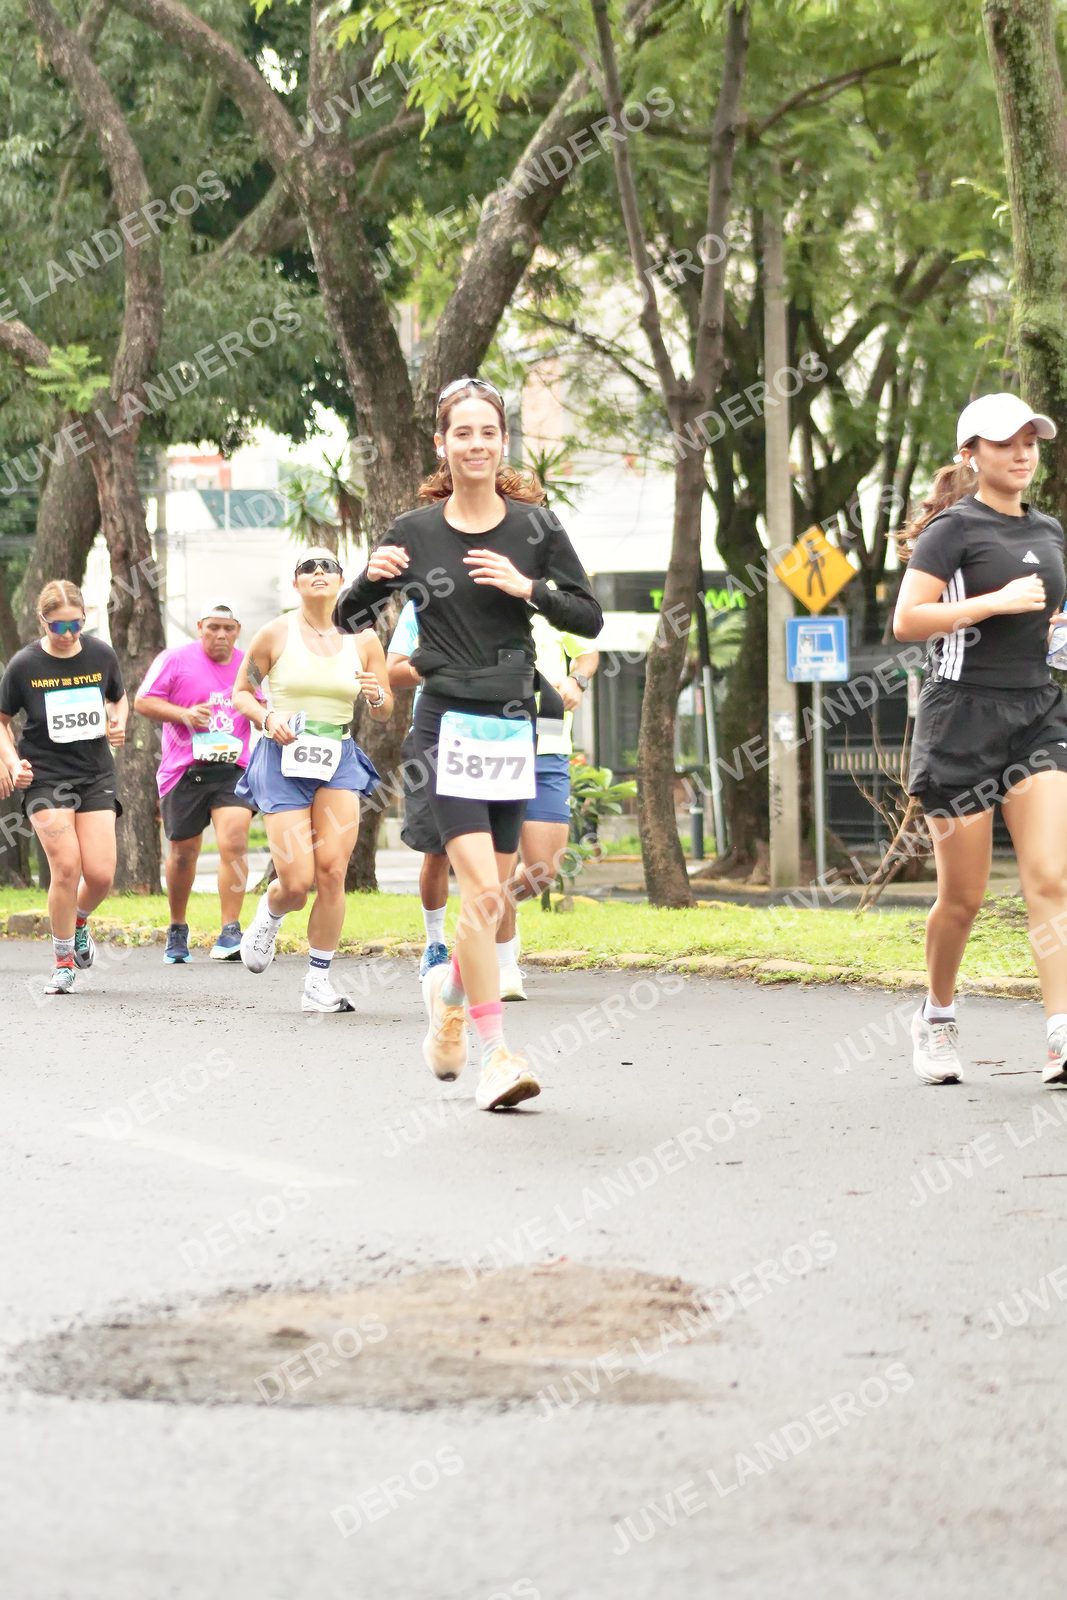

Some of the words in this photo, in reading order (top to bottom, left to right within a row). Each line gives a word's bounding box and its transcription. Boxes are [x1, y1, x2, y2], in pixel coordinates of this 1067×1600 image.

[31, 678, 59, 688] HARRY
[73, 672, 102, 685] STYLES
[52, 711, 100, 730] 5580
[294, 745, 333, 767] 652
[446, 750, 526, 780] 5877
